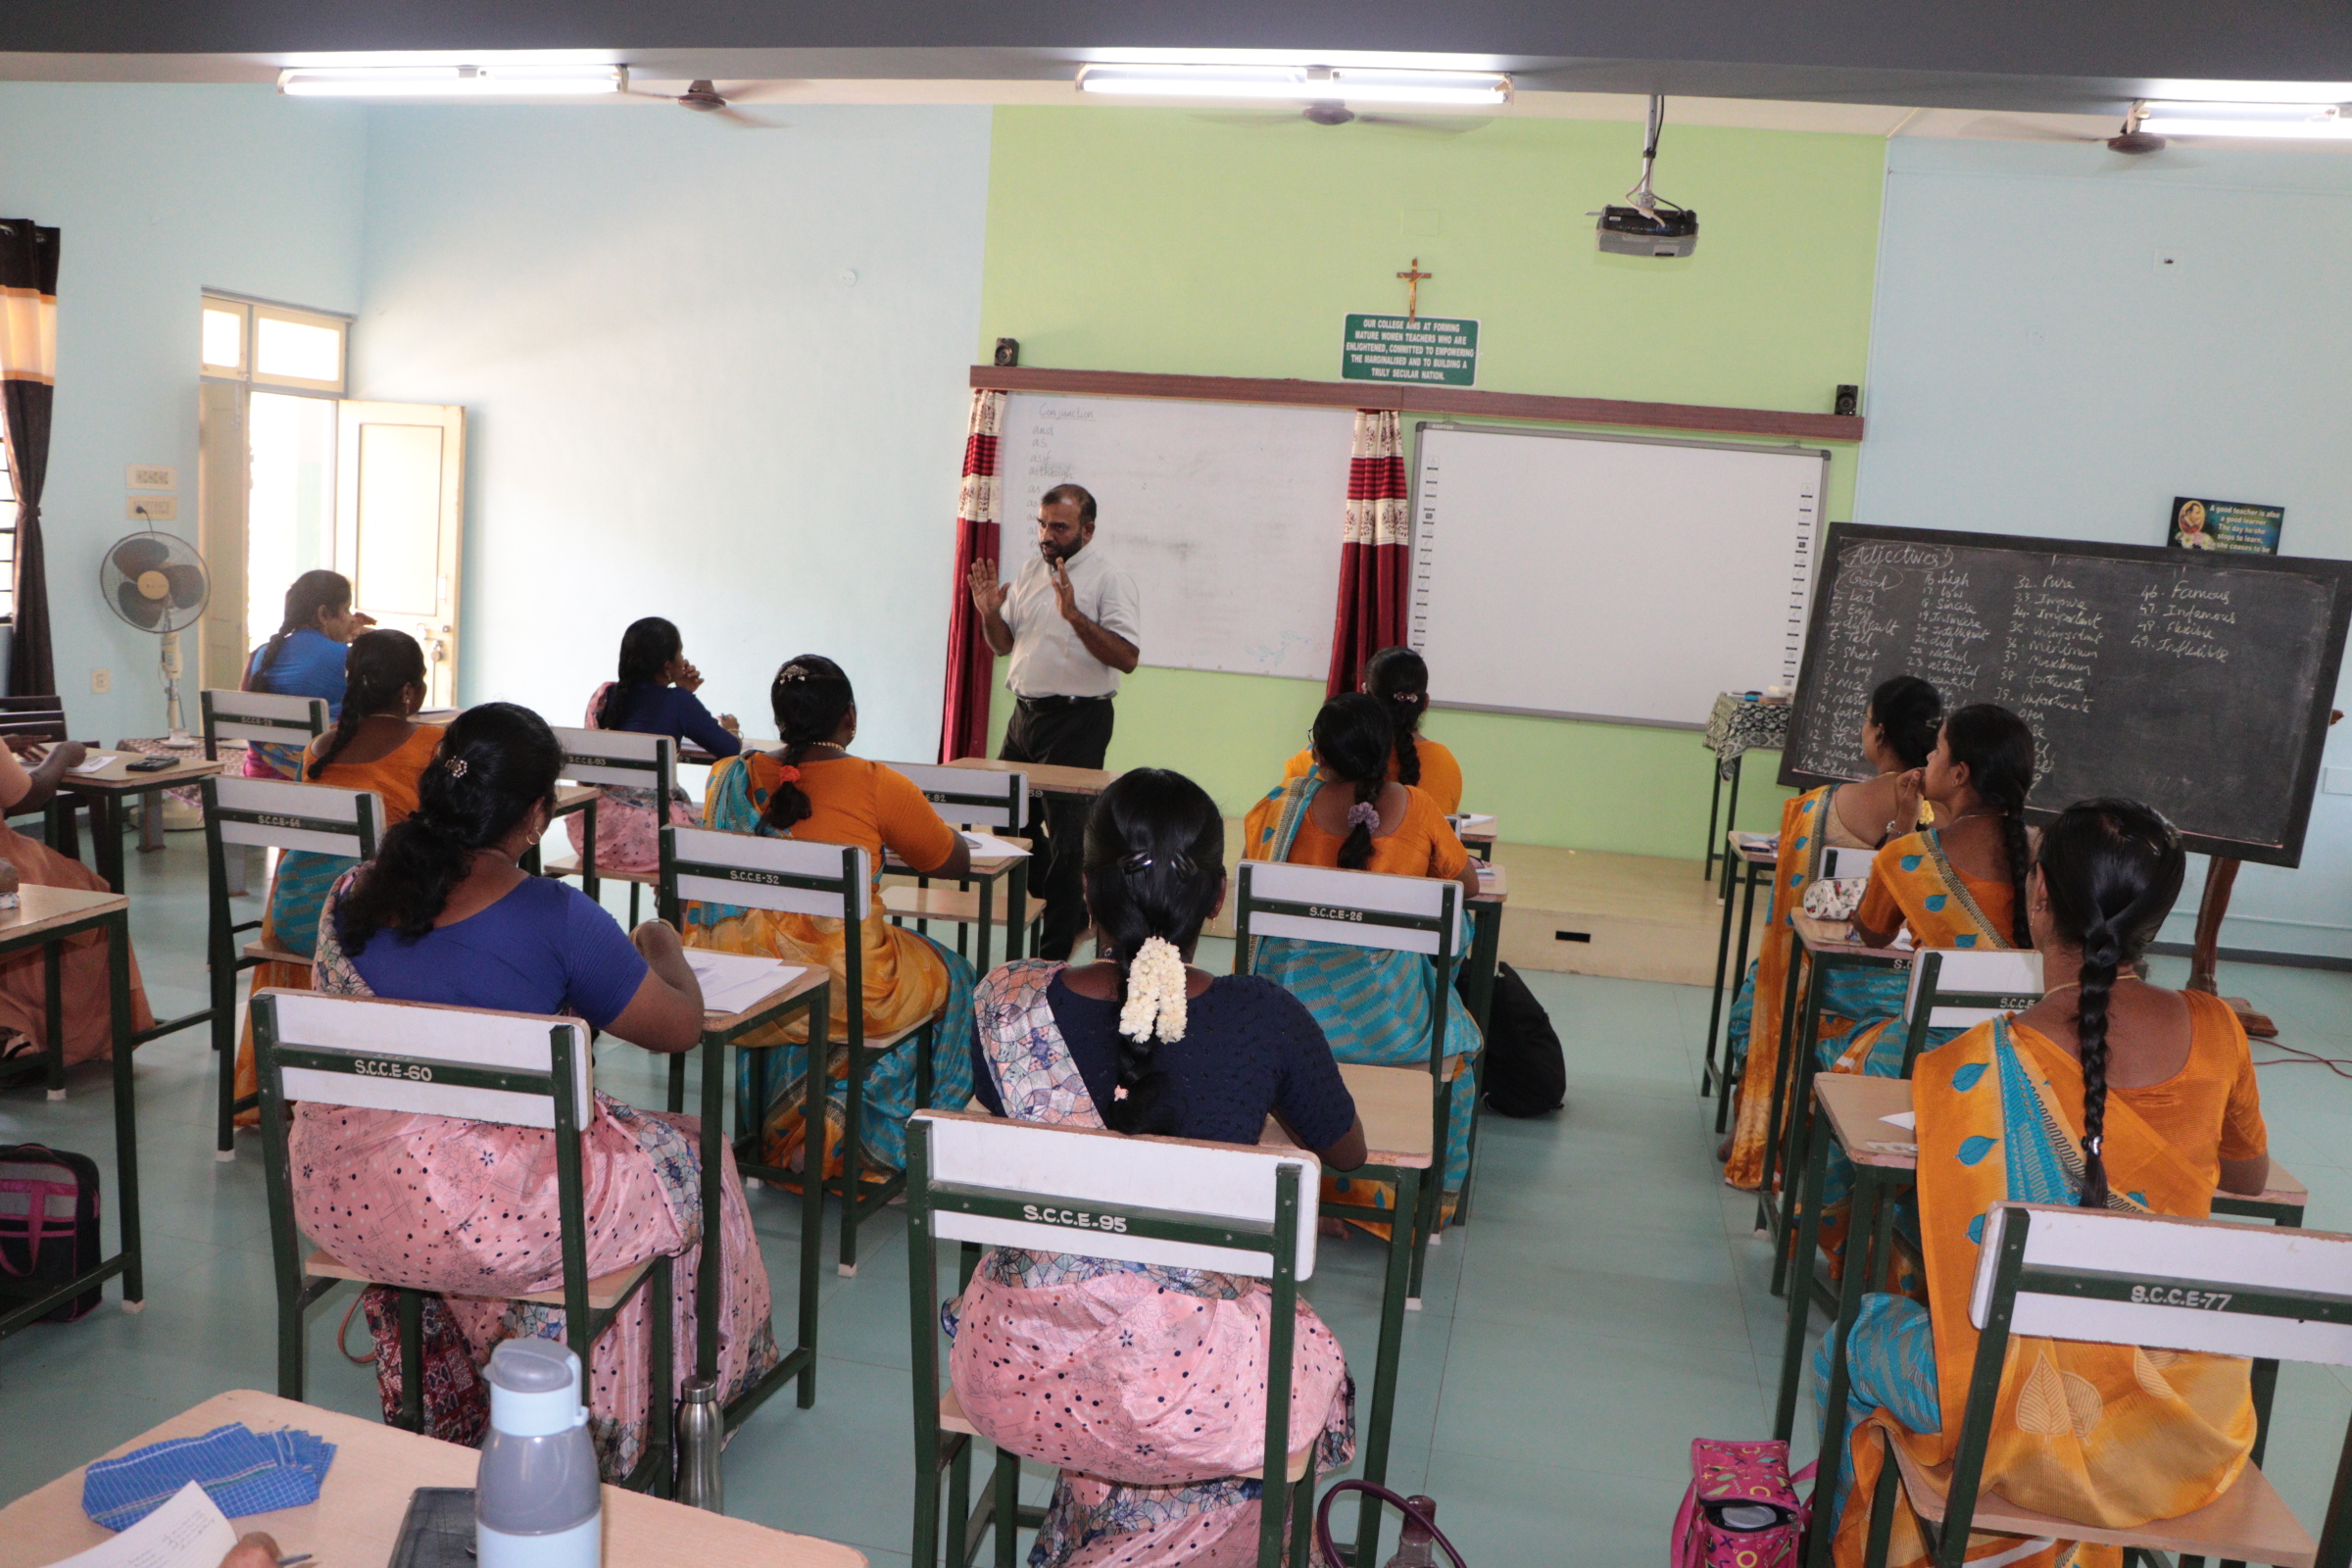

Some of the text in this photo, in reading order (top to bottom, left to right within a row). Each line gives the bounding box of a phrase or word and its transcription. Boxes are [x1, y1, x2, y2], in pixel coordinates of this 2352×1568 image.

[1363, 318, 1376, 328] OUR
[1378, 319, 1403, 329] COLLEGE
[1405, 321, 1421, 330] AIMS
[1434, 322, 1460, 333] FORMING
[1355, 330, 1467, 345] MATURE WOMEN TEACHERS WHO ARE
[1346, 342, 1388, 354] ENLIGHTENED,
[1390, 344, 1424, 354] COMMITTED
[1436, 347, 1474, 358] EMPOWERING
[1351, 354, 1362, 363] THE
[1364, 355, 1407, 366] MARGINALISED
[1408, 358, 1421, 367] AND
[1433, 360, 1461, 368] BUILDING
[1371, 368, 1446, 380] TRULY SECULAR NATION.
[2233, 507, 2258, 516] teacher
[2231, 525, 2243, 534] day
[1850, 545, 1938, 577] Adjectives
[730, 870, 779, 884] S.C.C.E-32
[1309, 906, 1363, 921] S.C.C.E-26
[355, 1059, 432, 1082] S.C.C.E-60
[1023, 1204, 1127, 1233] S.C.C.E-95
[2131, 1285, 2232, 1311] S.C.C.E-77
